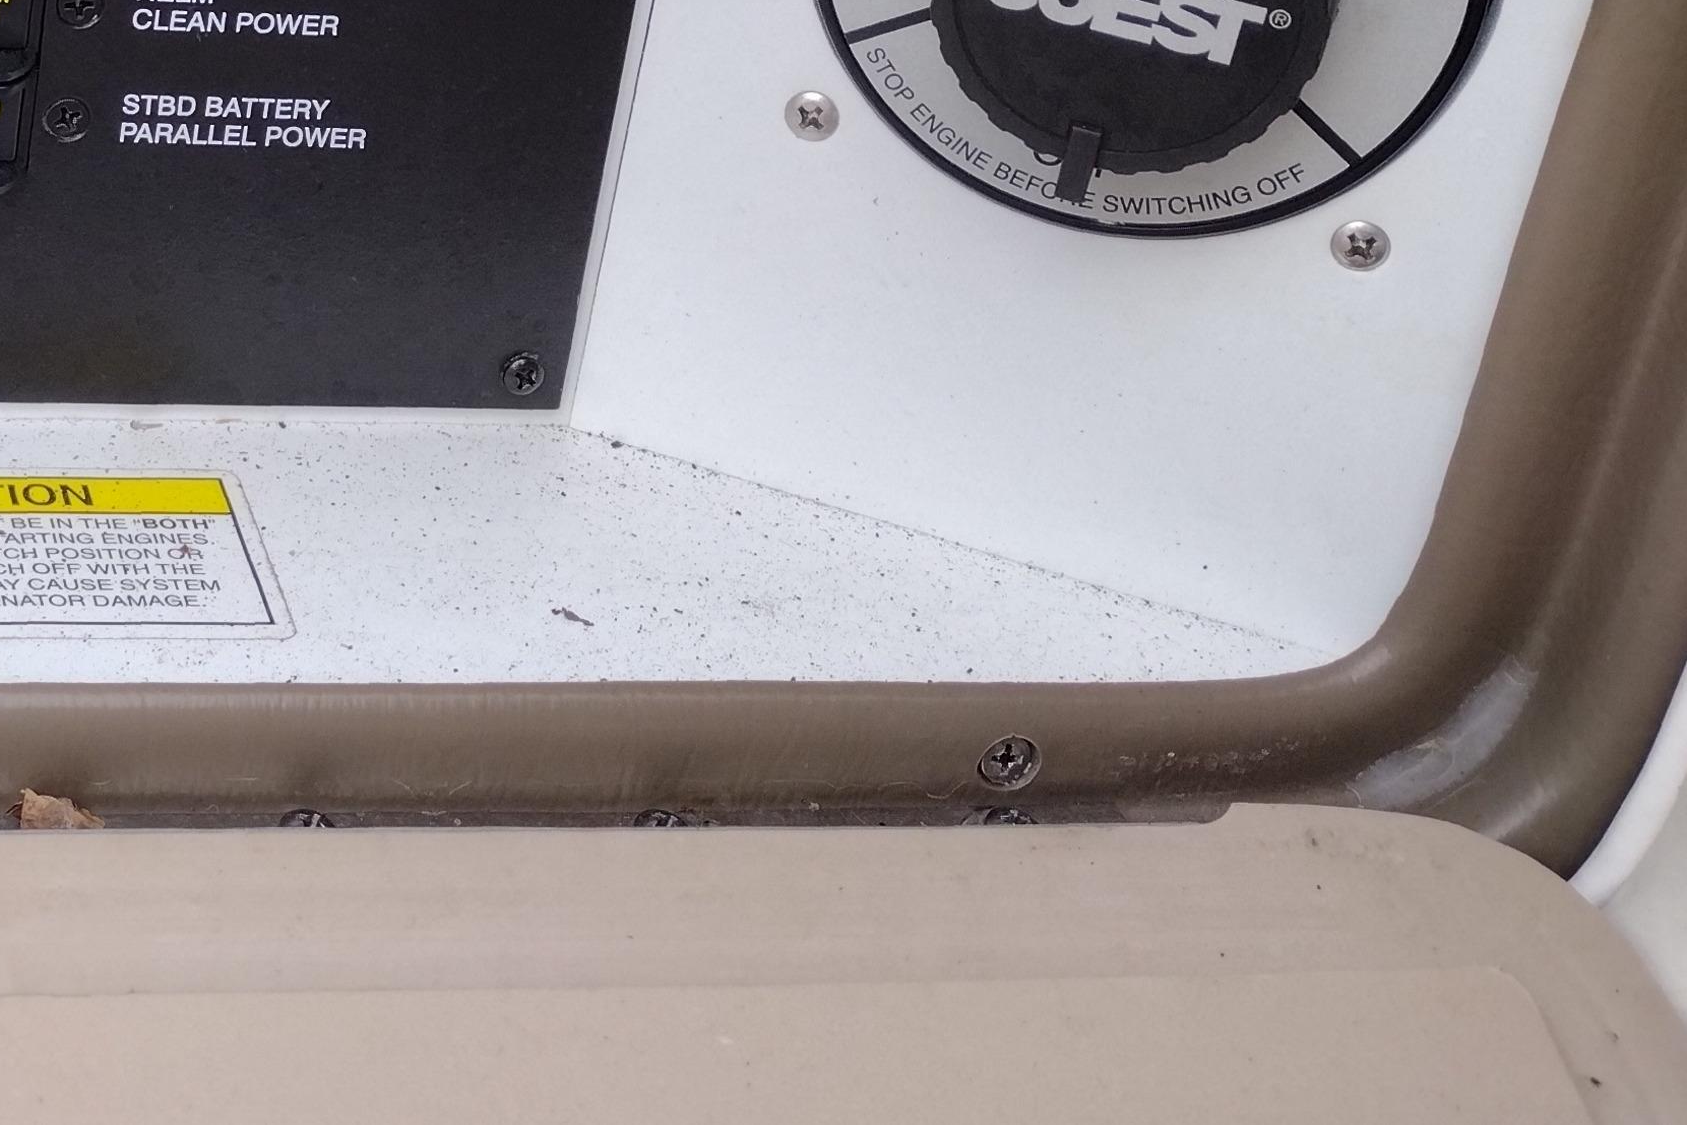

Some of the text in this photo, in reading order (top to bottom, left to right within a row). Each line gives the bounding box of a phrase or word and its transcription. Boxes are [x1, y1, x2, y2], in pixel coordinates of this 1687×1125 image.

[131, 7, 341, 38] CLEAN POWER
[122, 94, 332, 122] STBD BATTERY
[118, 122, 368, 151] PARALLEL POWER
[865, 46, 916, 102] STOP
[910, 102, 994, 171] ENGINE
[993, 161, 1096, 210] BEFOE
[1102, 184, 1253, 217] SWITCHING
[1258, 163, 1306, 198] OFF
[11, 517, 42, 530] BE
[49, 517, 73, 530] IN
[76, 517, 129, 530] THE
[101, 532, 215, 545] ENGINES.
[45, 548, 161, 560] POSITION
[166, 548, 204, 560] OR
[31, 562, 84, 575] OFF
[86, 563, 150, 576] WITH
[154, 563, 207, 576] THE
[27, 578, 113, 591] CAUSE
[120, 578, 222, 591] SYSTEM
